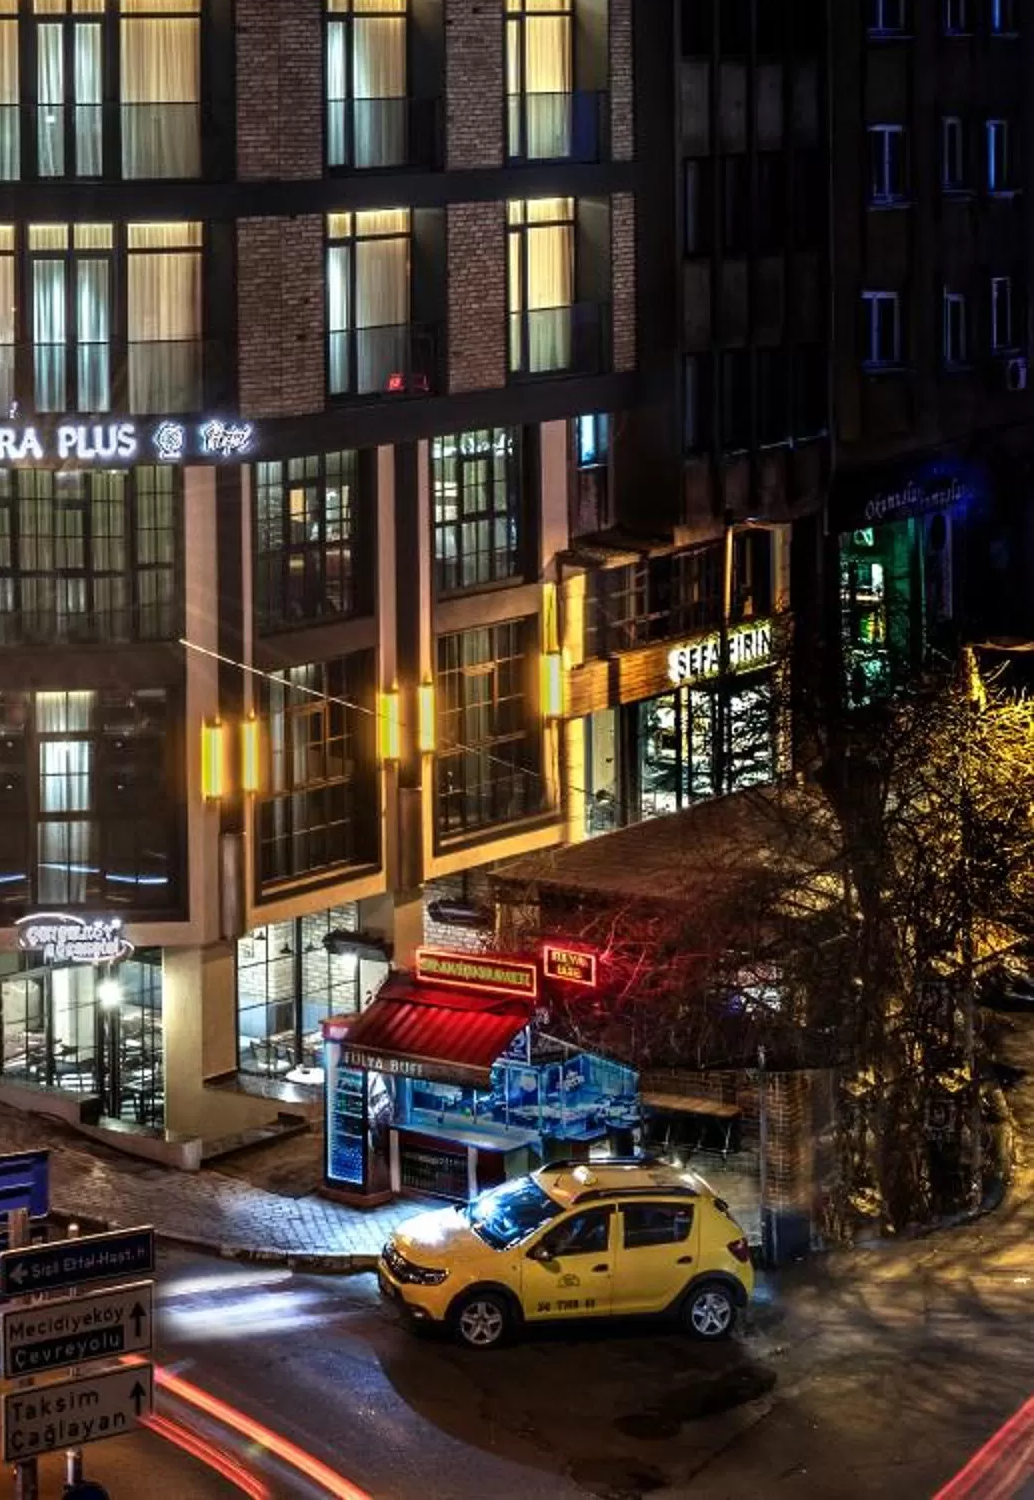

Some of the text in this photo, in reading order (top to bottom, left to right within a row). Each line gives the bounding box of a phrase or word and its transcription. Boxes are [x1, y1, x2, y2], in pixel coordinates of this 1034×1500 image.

[58, 423, 137, 458] PLUS
[677, 642, 721, 679] SEFA
[9, 1306, 124, 1341] Mecidiyeköy
[16, 1332, 120, 1369] Çevreyolu
[12, 1389, 99, 1422] Taksim
[11, 1411, 126, 1449] Çağlayan
